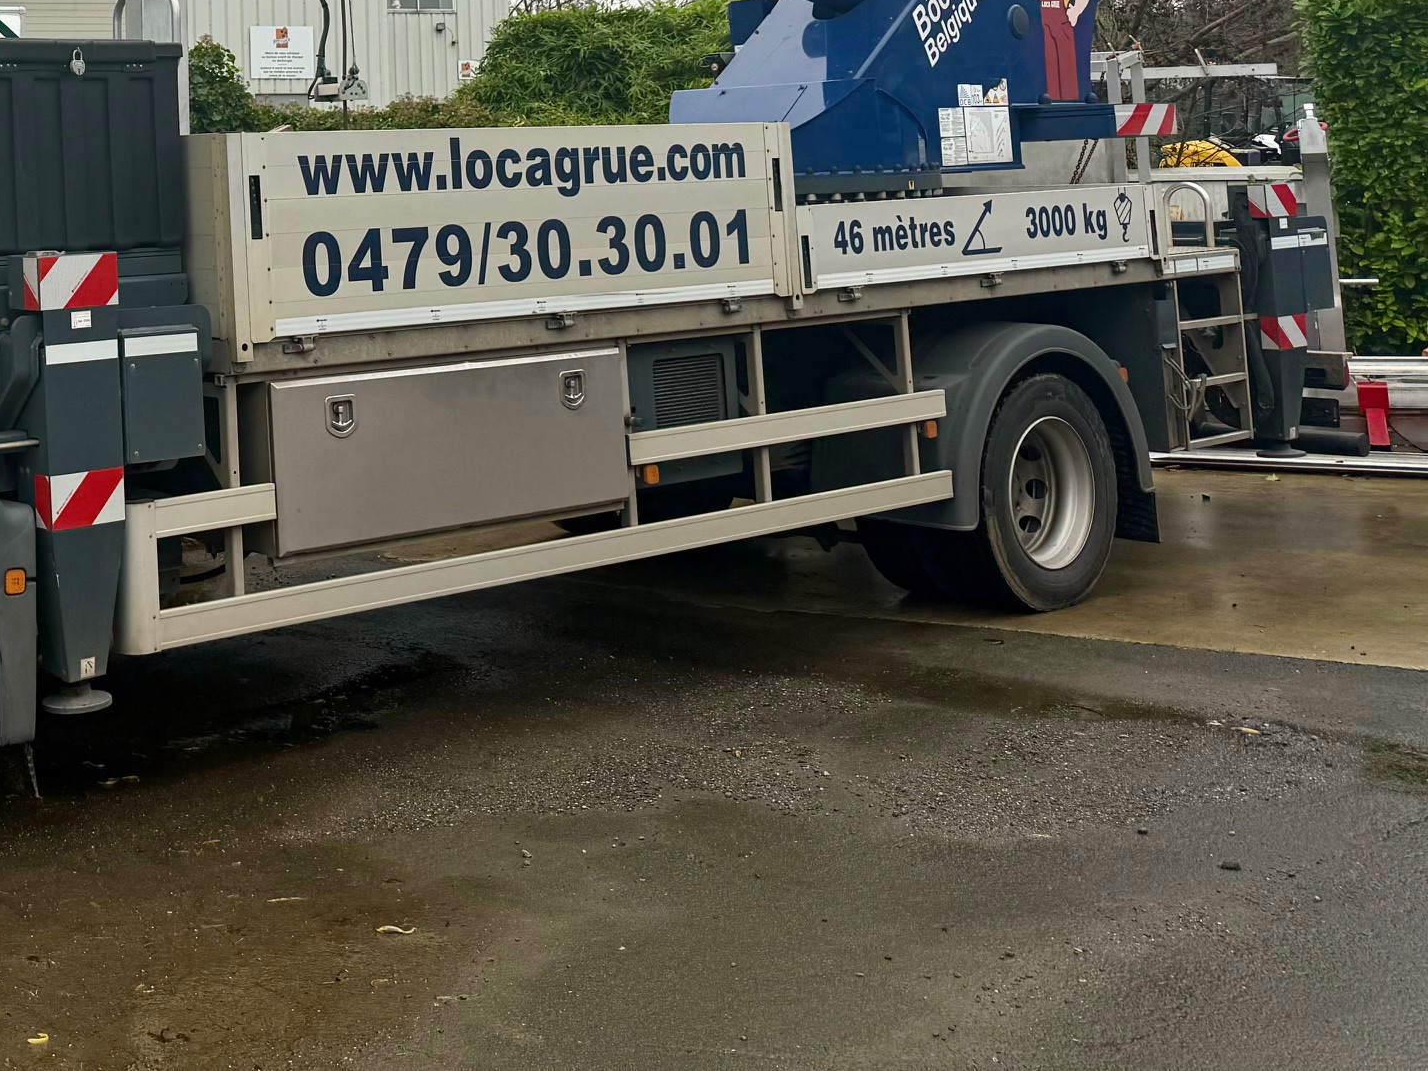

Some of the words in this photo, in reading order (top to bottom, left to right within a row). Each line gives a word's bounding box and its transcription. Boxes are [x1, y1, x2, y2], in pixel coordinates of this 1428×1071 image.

[296, 137, 747, 197] www.locagrue.com
[833, 219, 864, 255] 46
[872, 214, 956, 253] mètres
[1025, 203, 1075, 239] 3000
[1082, 202, 1107, 240] kg
[301, 208, 750, 298] 0479/30.30.01
